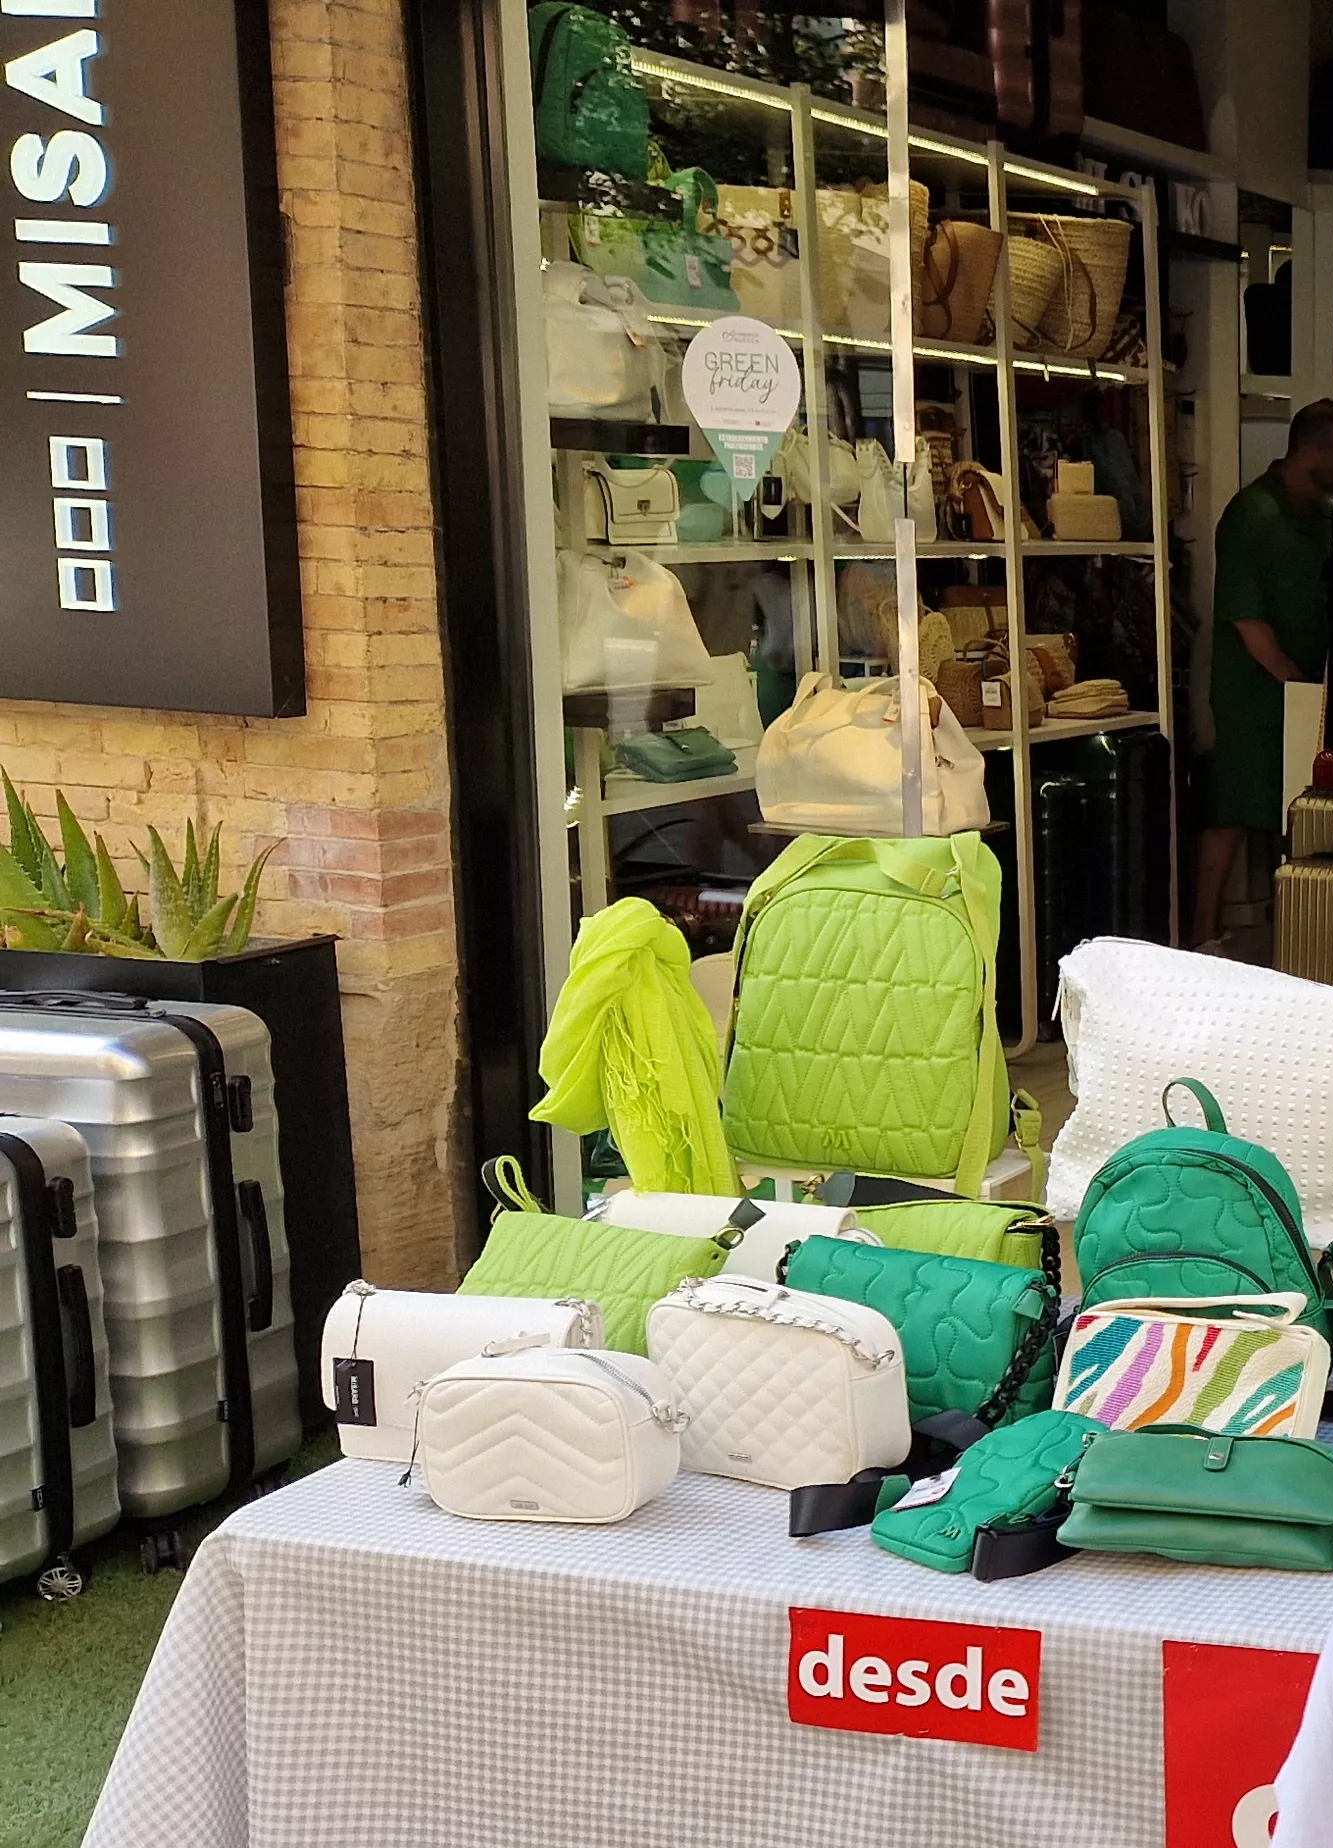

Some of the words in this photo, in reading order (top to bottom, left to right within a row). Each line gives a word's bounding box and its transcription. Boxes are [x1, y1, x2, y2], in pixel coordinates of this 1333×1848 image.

[705, 351, 779, 374] GREEN
[709, 364, 779, 404] friday
[798, 1633, 1030, 1716] desde
